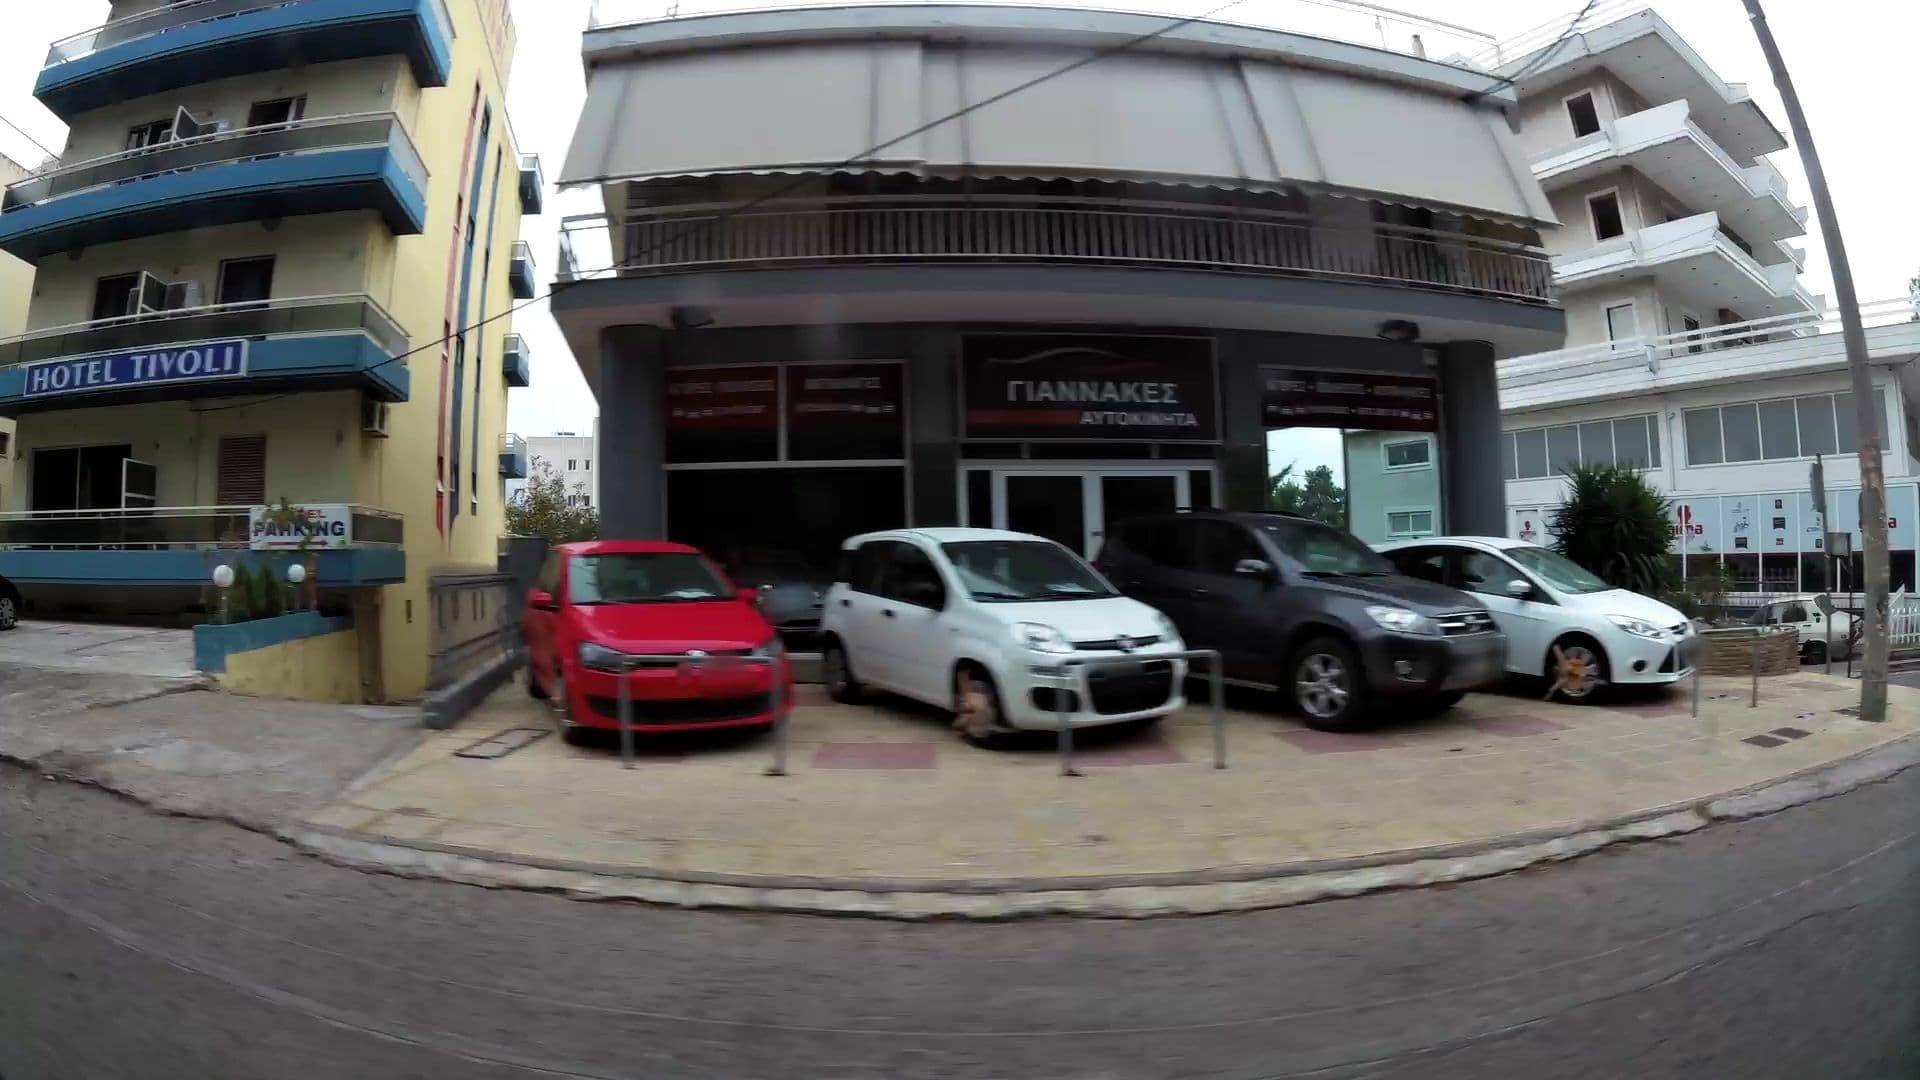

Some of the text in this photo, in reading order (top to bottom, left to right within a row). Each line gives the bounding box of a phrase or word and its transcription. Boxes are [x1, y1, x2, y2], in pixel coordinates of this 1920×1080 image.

[32, 346, 234, 392] HOTEL TIVOLI
[1007, 380, 1179, 404] ΓΙΑΝΝΑΚΕΣ
[254, 520, 345, 537] PARKNG
